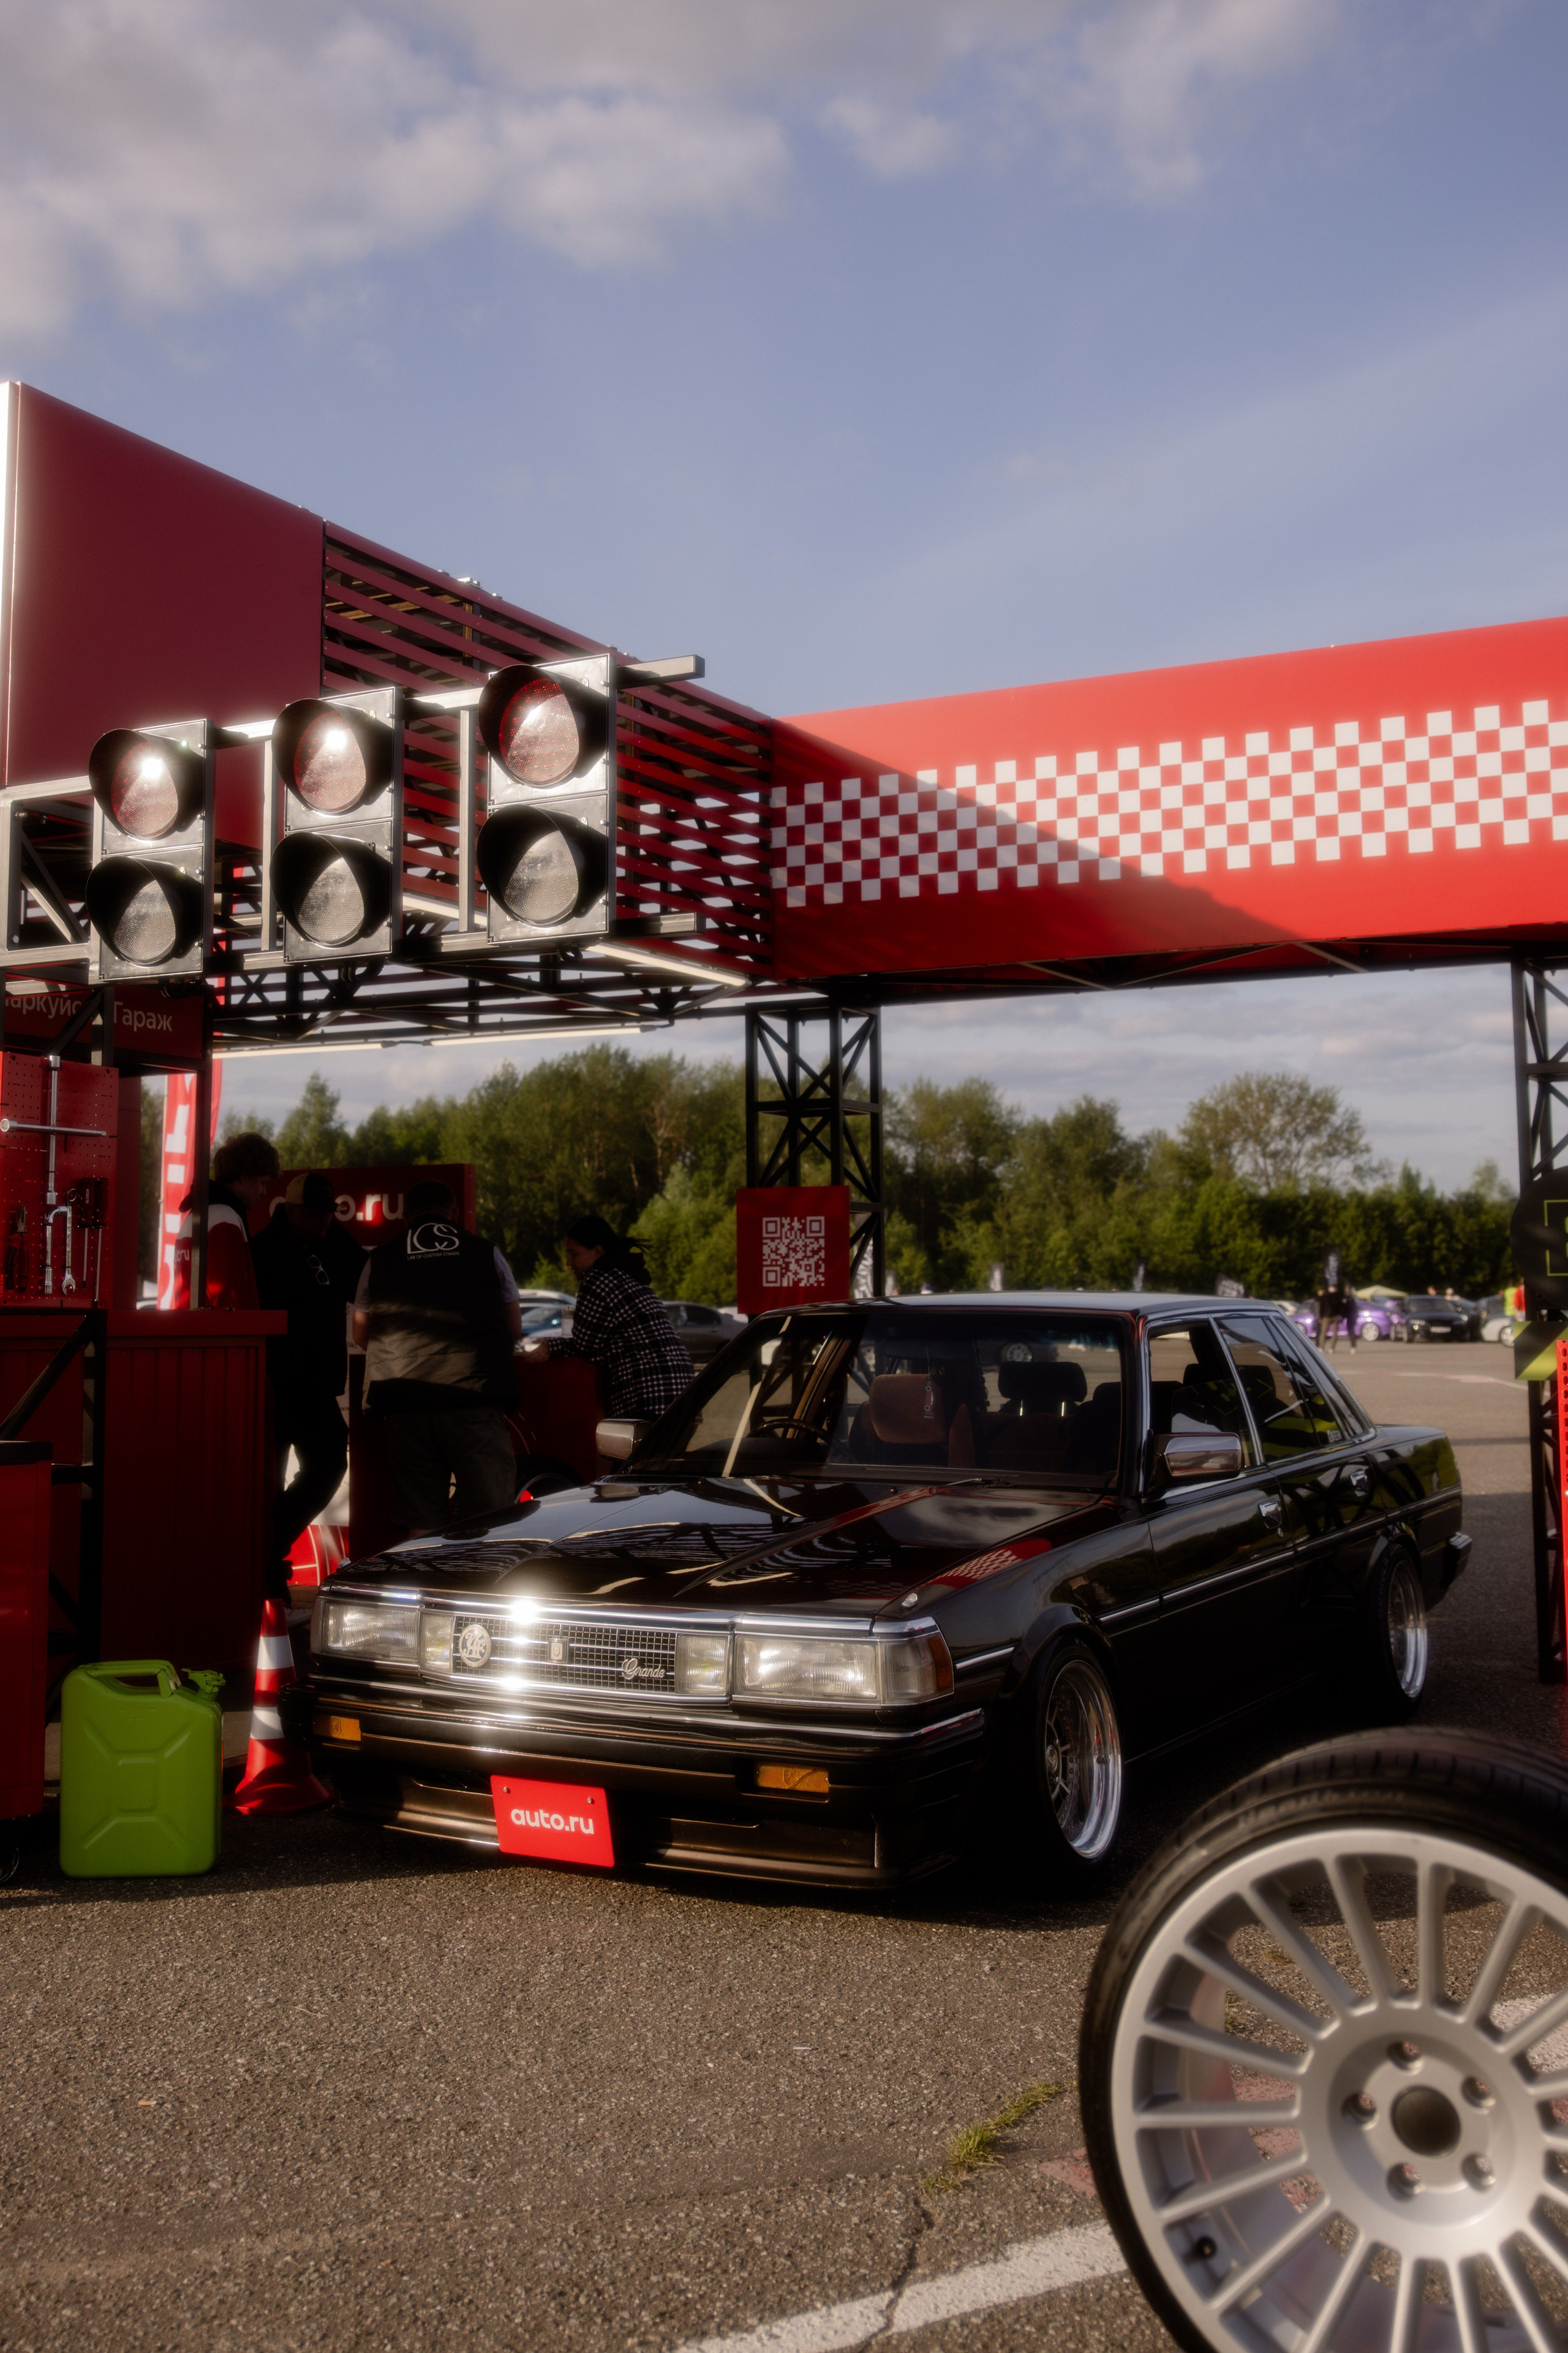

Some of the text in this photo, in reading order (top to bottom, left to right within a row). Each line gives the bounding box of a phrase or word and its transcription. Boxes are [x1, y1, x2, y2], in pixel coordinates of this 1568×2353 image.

[113, 1000, 173, 1032] Гараж
[406, 1222, 459, 1255] LCS
[621, 1657, 666, 1680] Grande
[510, 1808, 595, 1835] auto.ru
